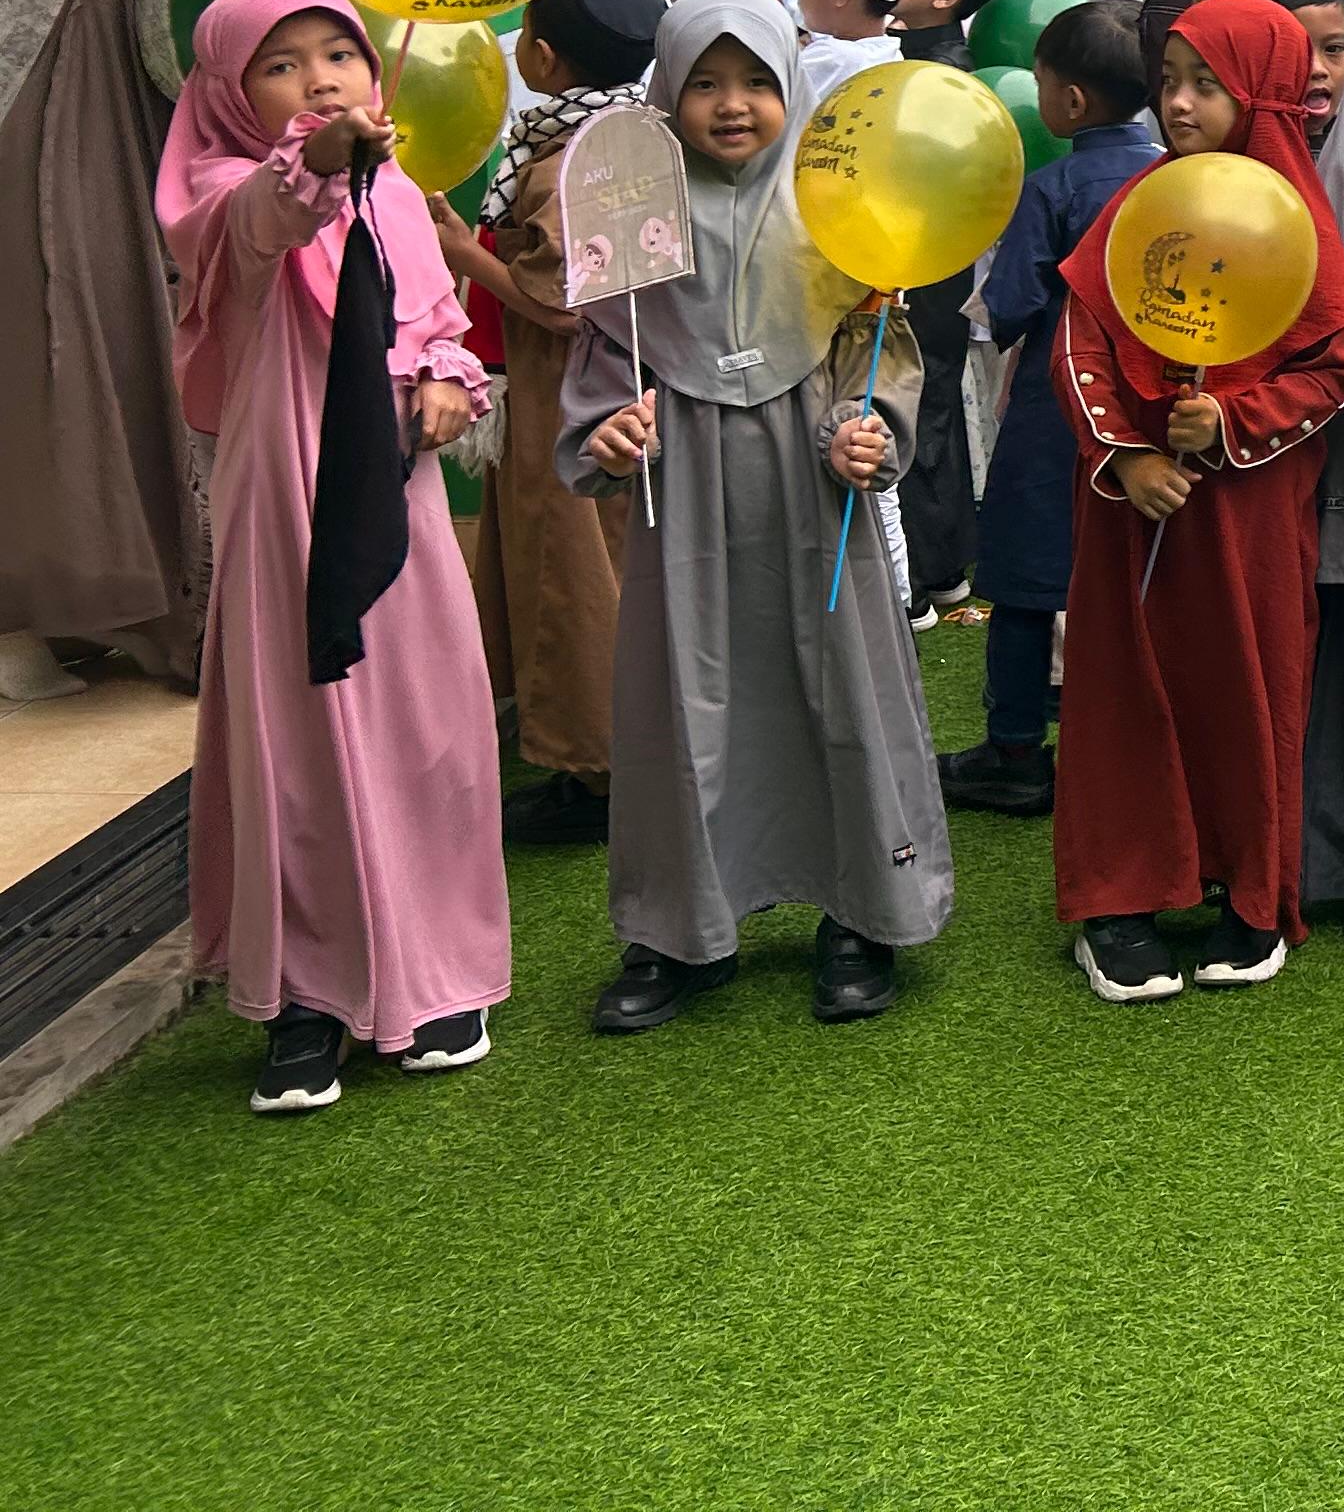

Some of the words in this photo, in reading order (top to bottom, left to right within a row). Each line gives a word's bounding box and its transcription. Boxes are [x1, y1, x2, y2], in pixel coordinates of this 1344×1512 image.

[583, 165, 614, 187] AKU
[1138, 288, 1215, 331] Ramadan
[1144, 308, 1198, 339] Kareem
